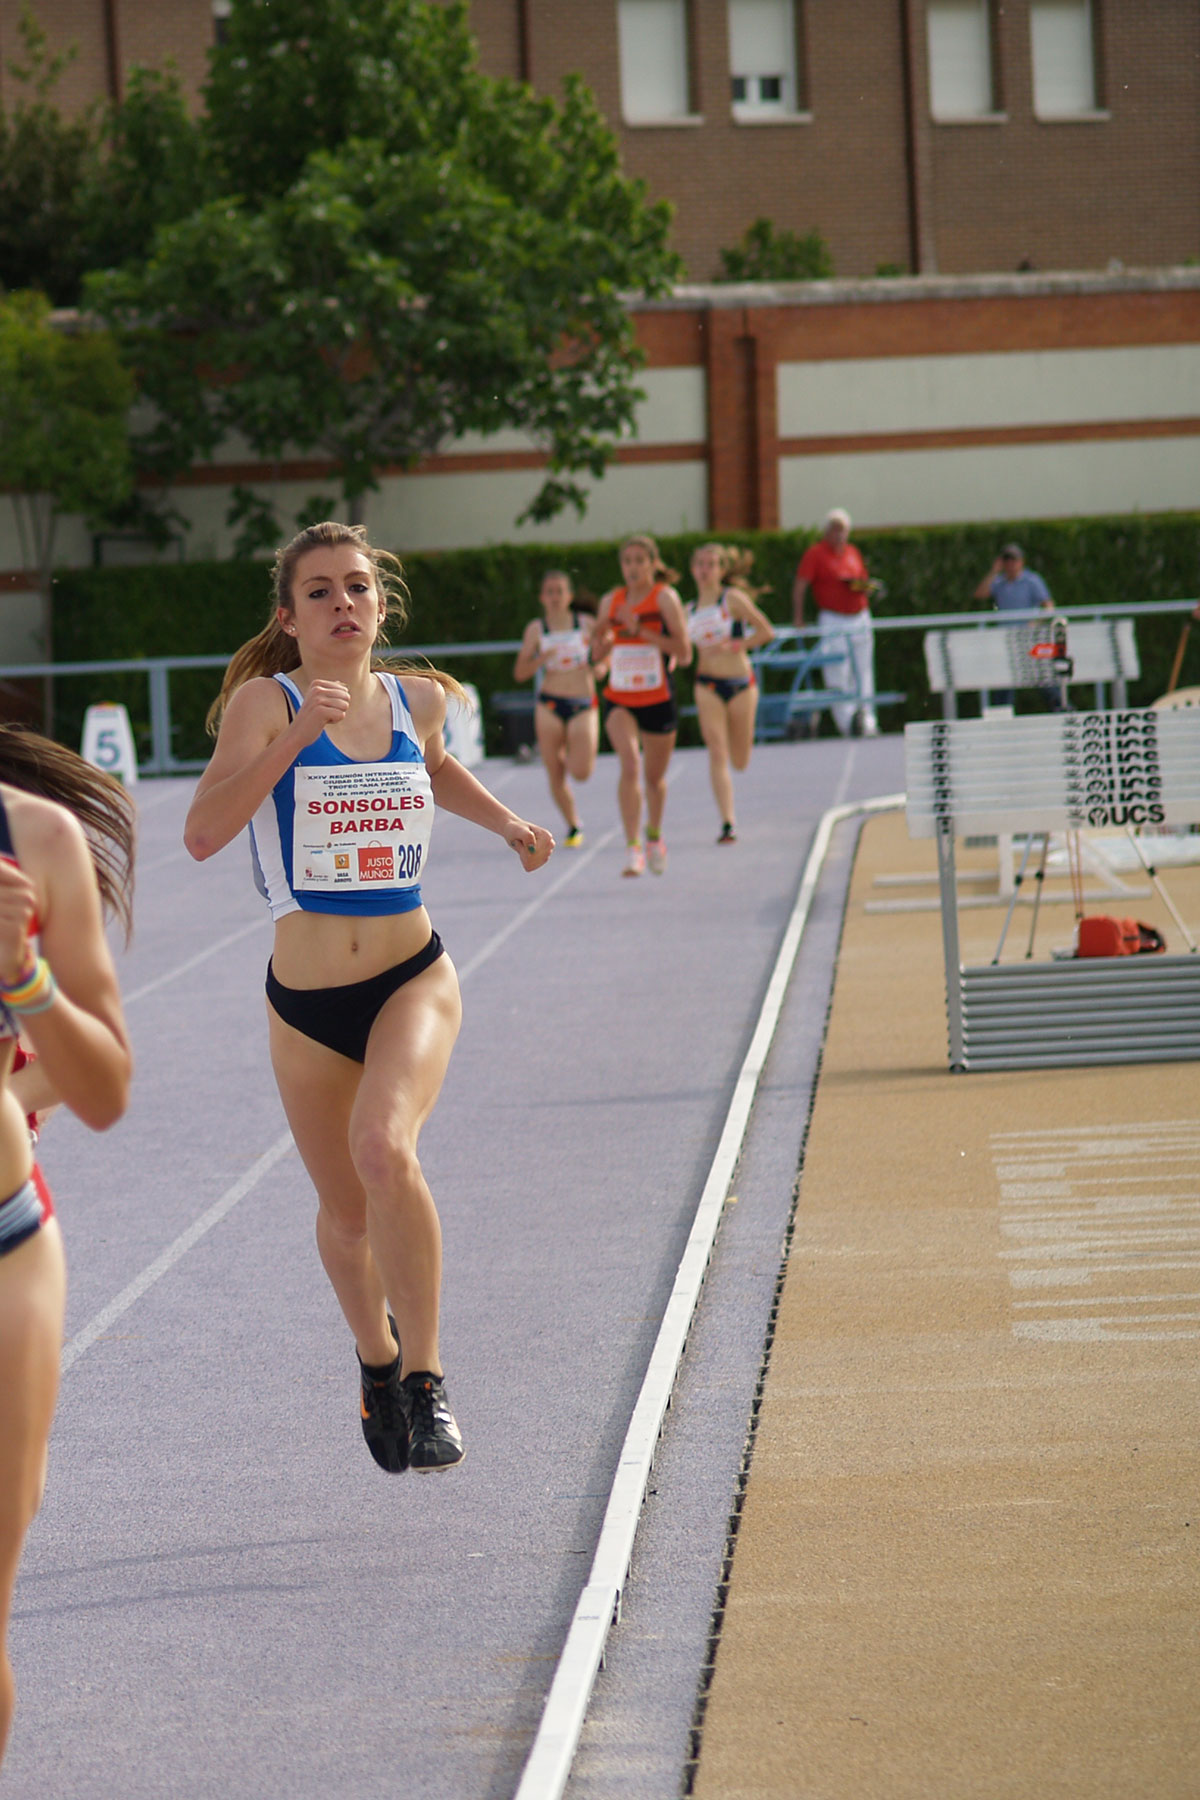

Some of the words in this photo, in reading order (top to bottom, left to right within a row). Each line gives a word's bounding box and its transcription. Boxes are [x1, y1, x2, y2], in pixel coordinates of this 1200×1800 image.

[95, 730, 120, 768] 5
[307, 795, 425, 815] SONSOLES
[1110, 803, 1165, 826] UCS
[330, 818, 405, 835] BARBA
[366, 856, 394, 868] JUSTO
[398, 843, 422, 879] 208
[360, 867, 394, 880] MUÑOZ
